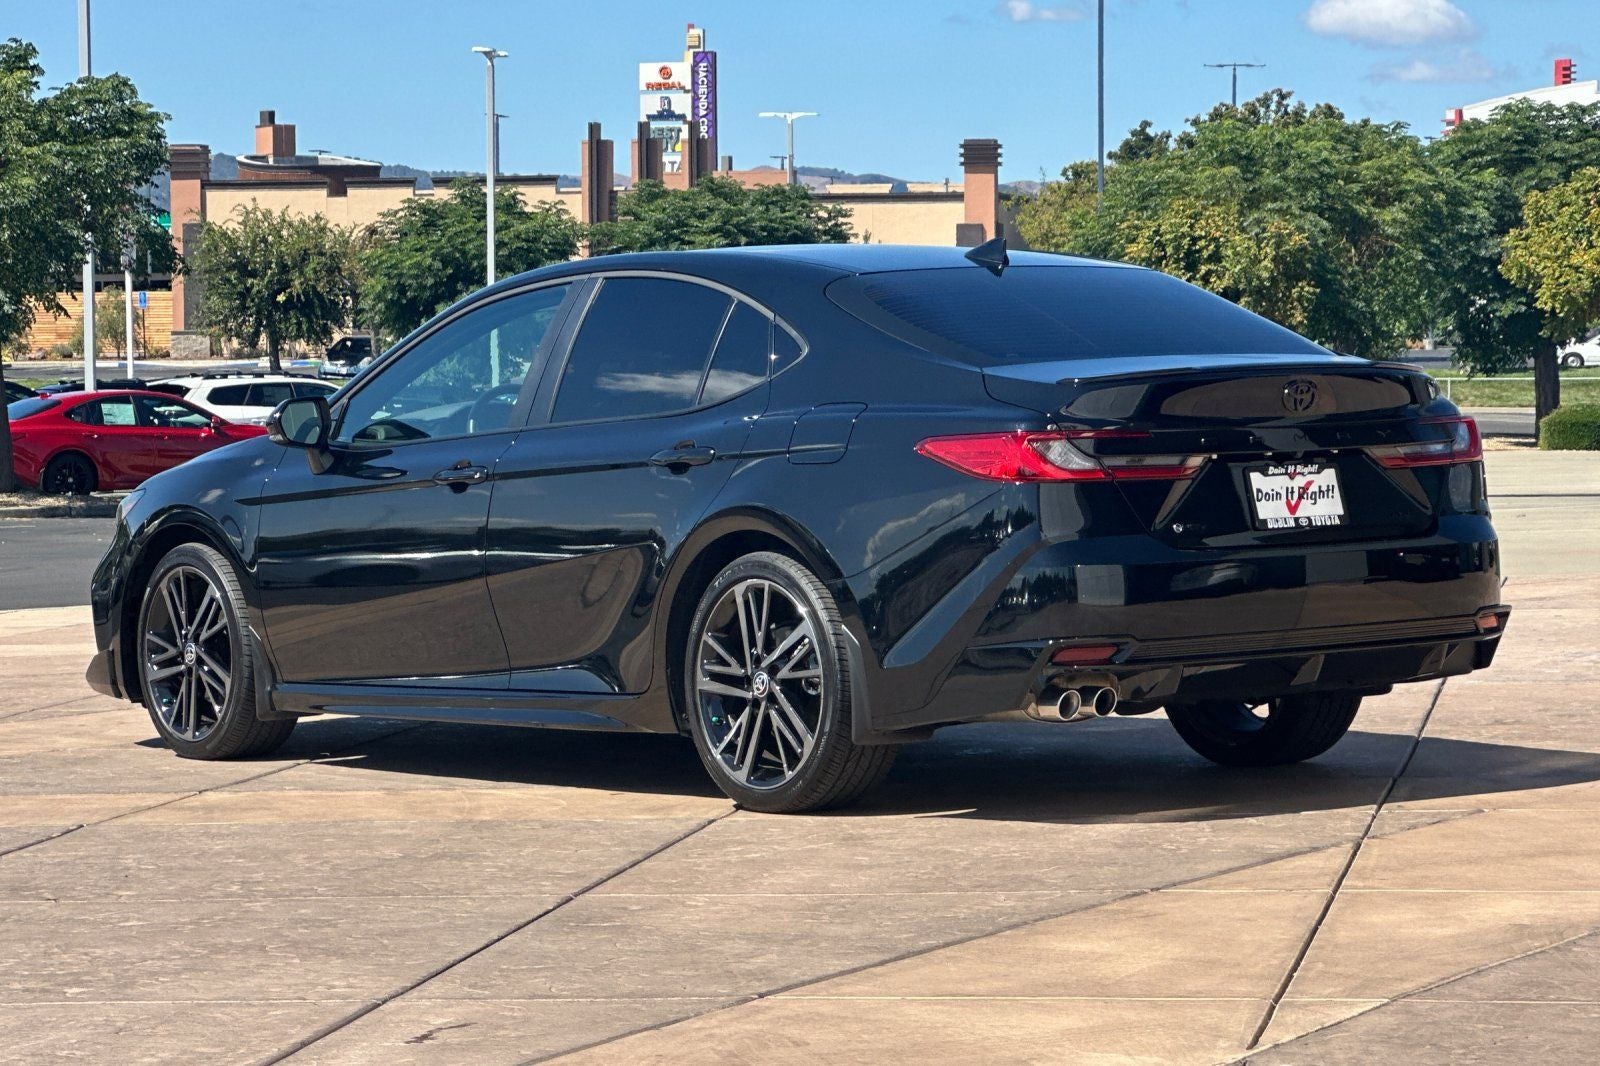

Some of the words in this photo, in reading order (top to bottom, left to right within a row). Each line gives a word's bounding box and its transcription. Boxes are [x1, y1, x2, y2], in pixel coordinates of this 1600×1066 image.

[646, 82, 684, 91] REGAL
[699, 62, 708, 116] HACIENDA
[1288, 465, 1295, 473] It
[1286, 486, 1295, 501] It
[1298, 484, 1335, 505] Right!
[1267, 518, 1295, 528] DUBLIN
[1311, 515, 1340, 526] TOYOTA
